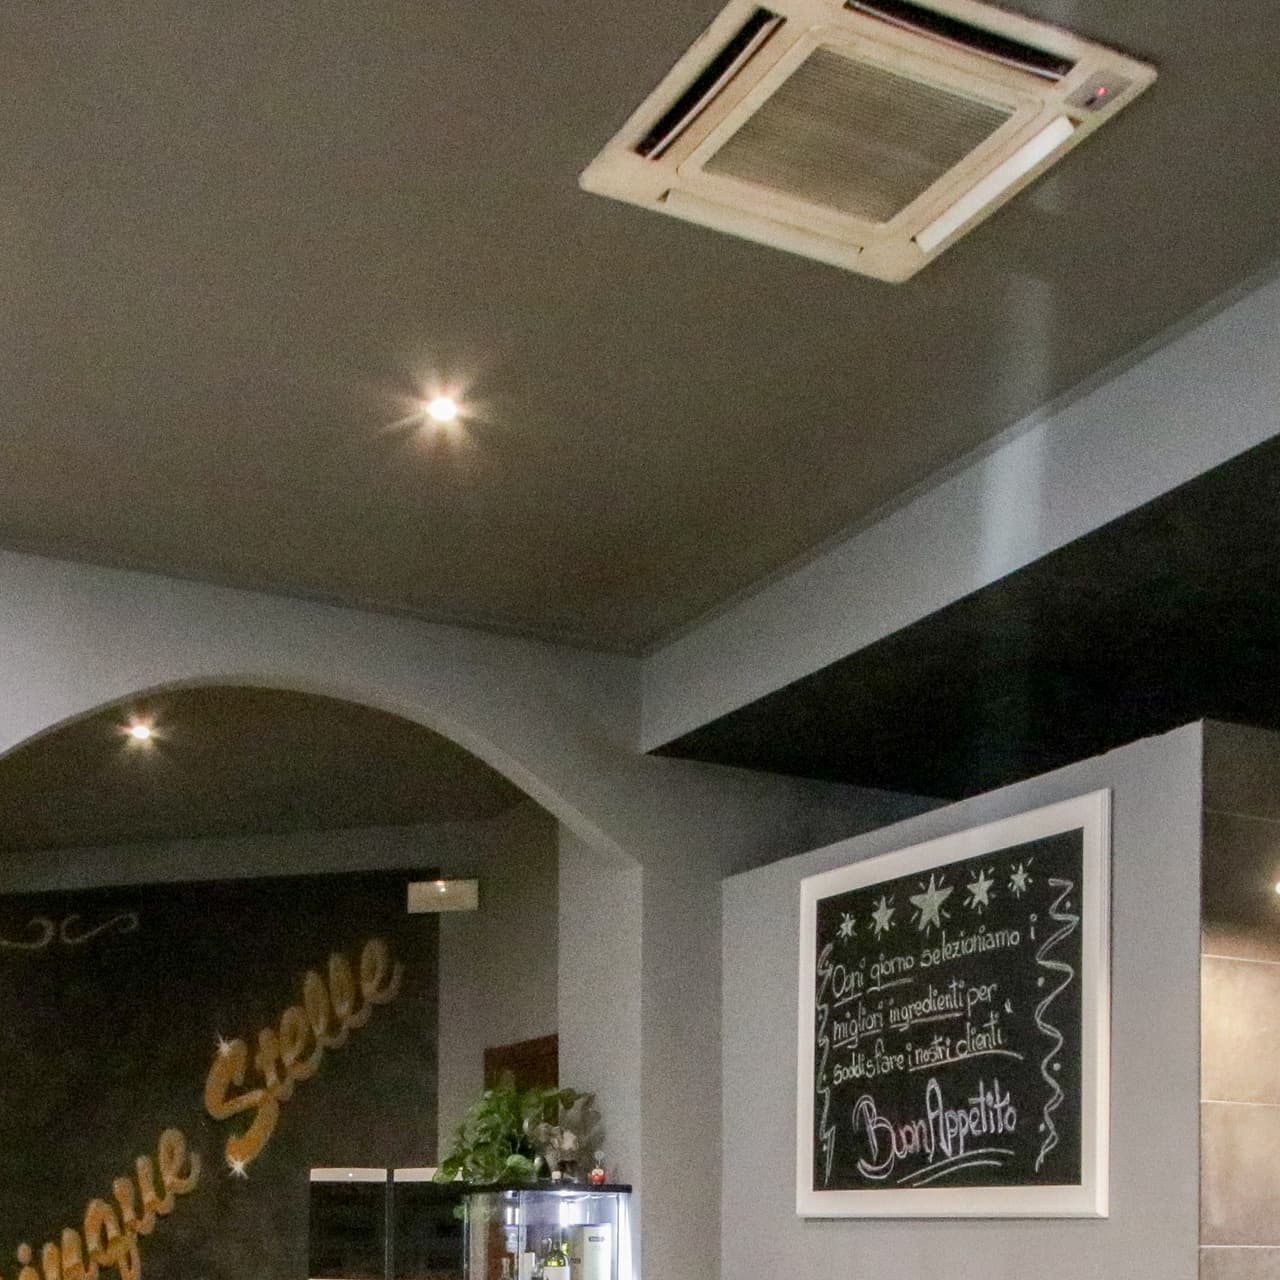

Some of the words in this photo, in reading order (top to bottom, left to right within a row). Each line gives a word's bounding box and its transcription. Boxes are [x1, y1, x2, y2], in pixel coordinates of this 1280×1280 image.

[832, 957, 866, 1000] Ogni
[870, 953, 915, 990] giorno
[920, 925, 1020, 967] selezioniamo
[1029, 913, 1038, 940] i
[205, 939, 404, 1166] Stelle
[833, 1001, 884, 1048] migliori
[889, 977, 964, 1031] ingredienti
[967, 983, 997, 1016] per
[915, 1034, 951, 1064] nostri
[956, 1011, 1003, 1055] clienti
[852, 1094, 931, 1180] Buon
[925, 1077, 1017, 1163] Appetito
